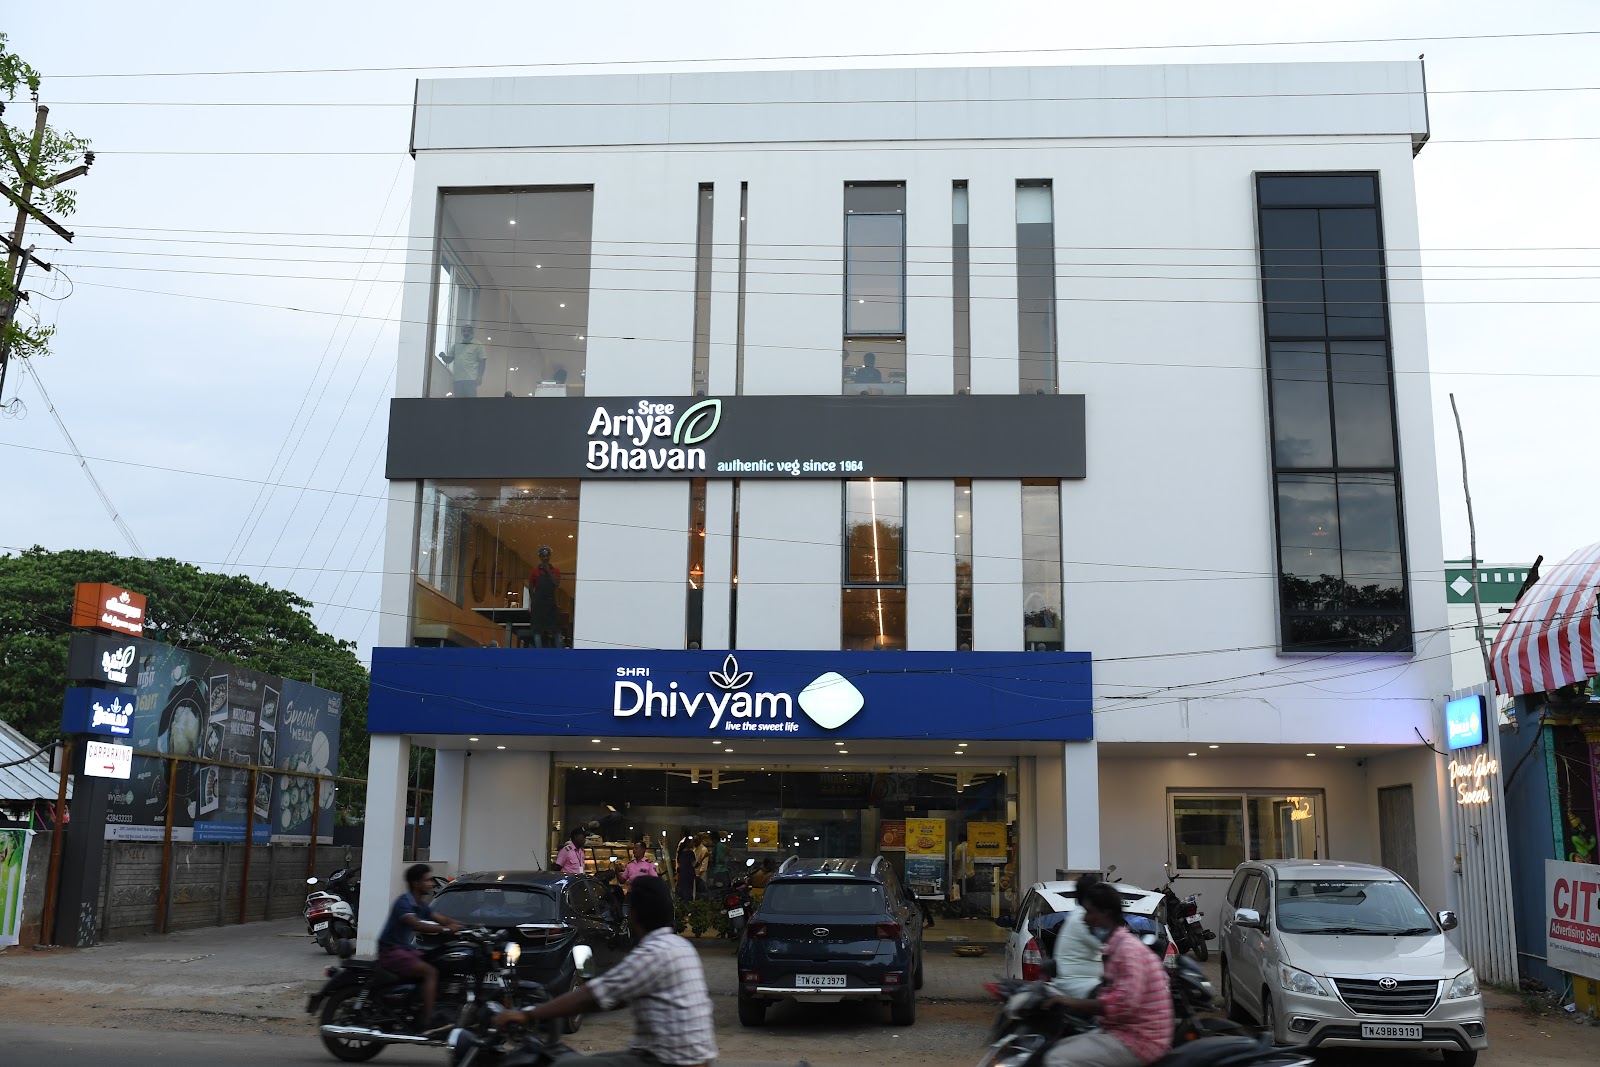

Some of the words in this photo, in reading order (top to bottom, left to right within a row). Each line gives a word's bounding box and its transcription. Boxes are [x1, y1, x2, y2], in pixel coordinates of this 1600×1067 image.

[638, 400, 674, 415] Sree
[587, 406, 672, 446] Ariya
[586, 440, 706, 470] Bhavan
[718, 459, 774, 472] authentic
[777, 459, 800, 476] veg
[803, 459, 836, 472] since
[839, 460, 864, 472] 1964
[616, 667, 650, 677] SHRI
[613, 680, 793, 729] Dhivyam
[284, 700, 320, 734] Special
[292, 728, 312, 742] MEALS
[726, 721, 741, 730] live
[742, 722, 757, 731] the
[758, 722, 784, 731] sweet
[785, 722, 799, 732] life
[1554, 878, 1600, 922] CIT
[1551, 922, 1584, 942] Advertising
[802, 976, 810, 985] TN
[827, 977, 845, 985] 3979
